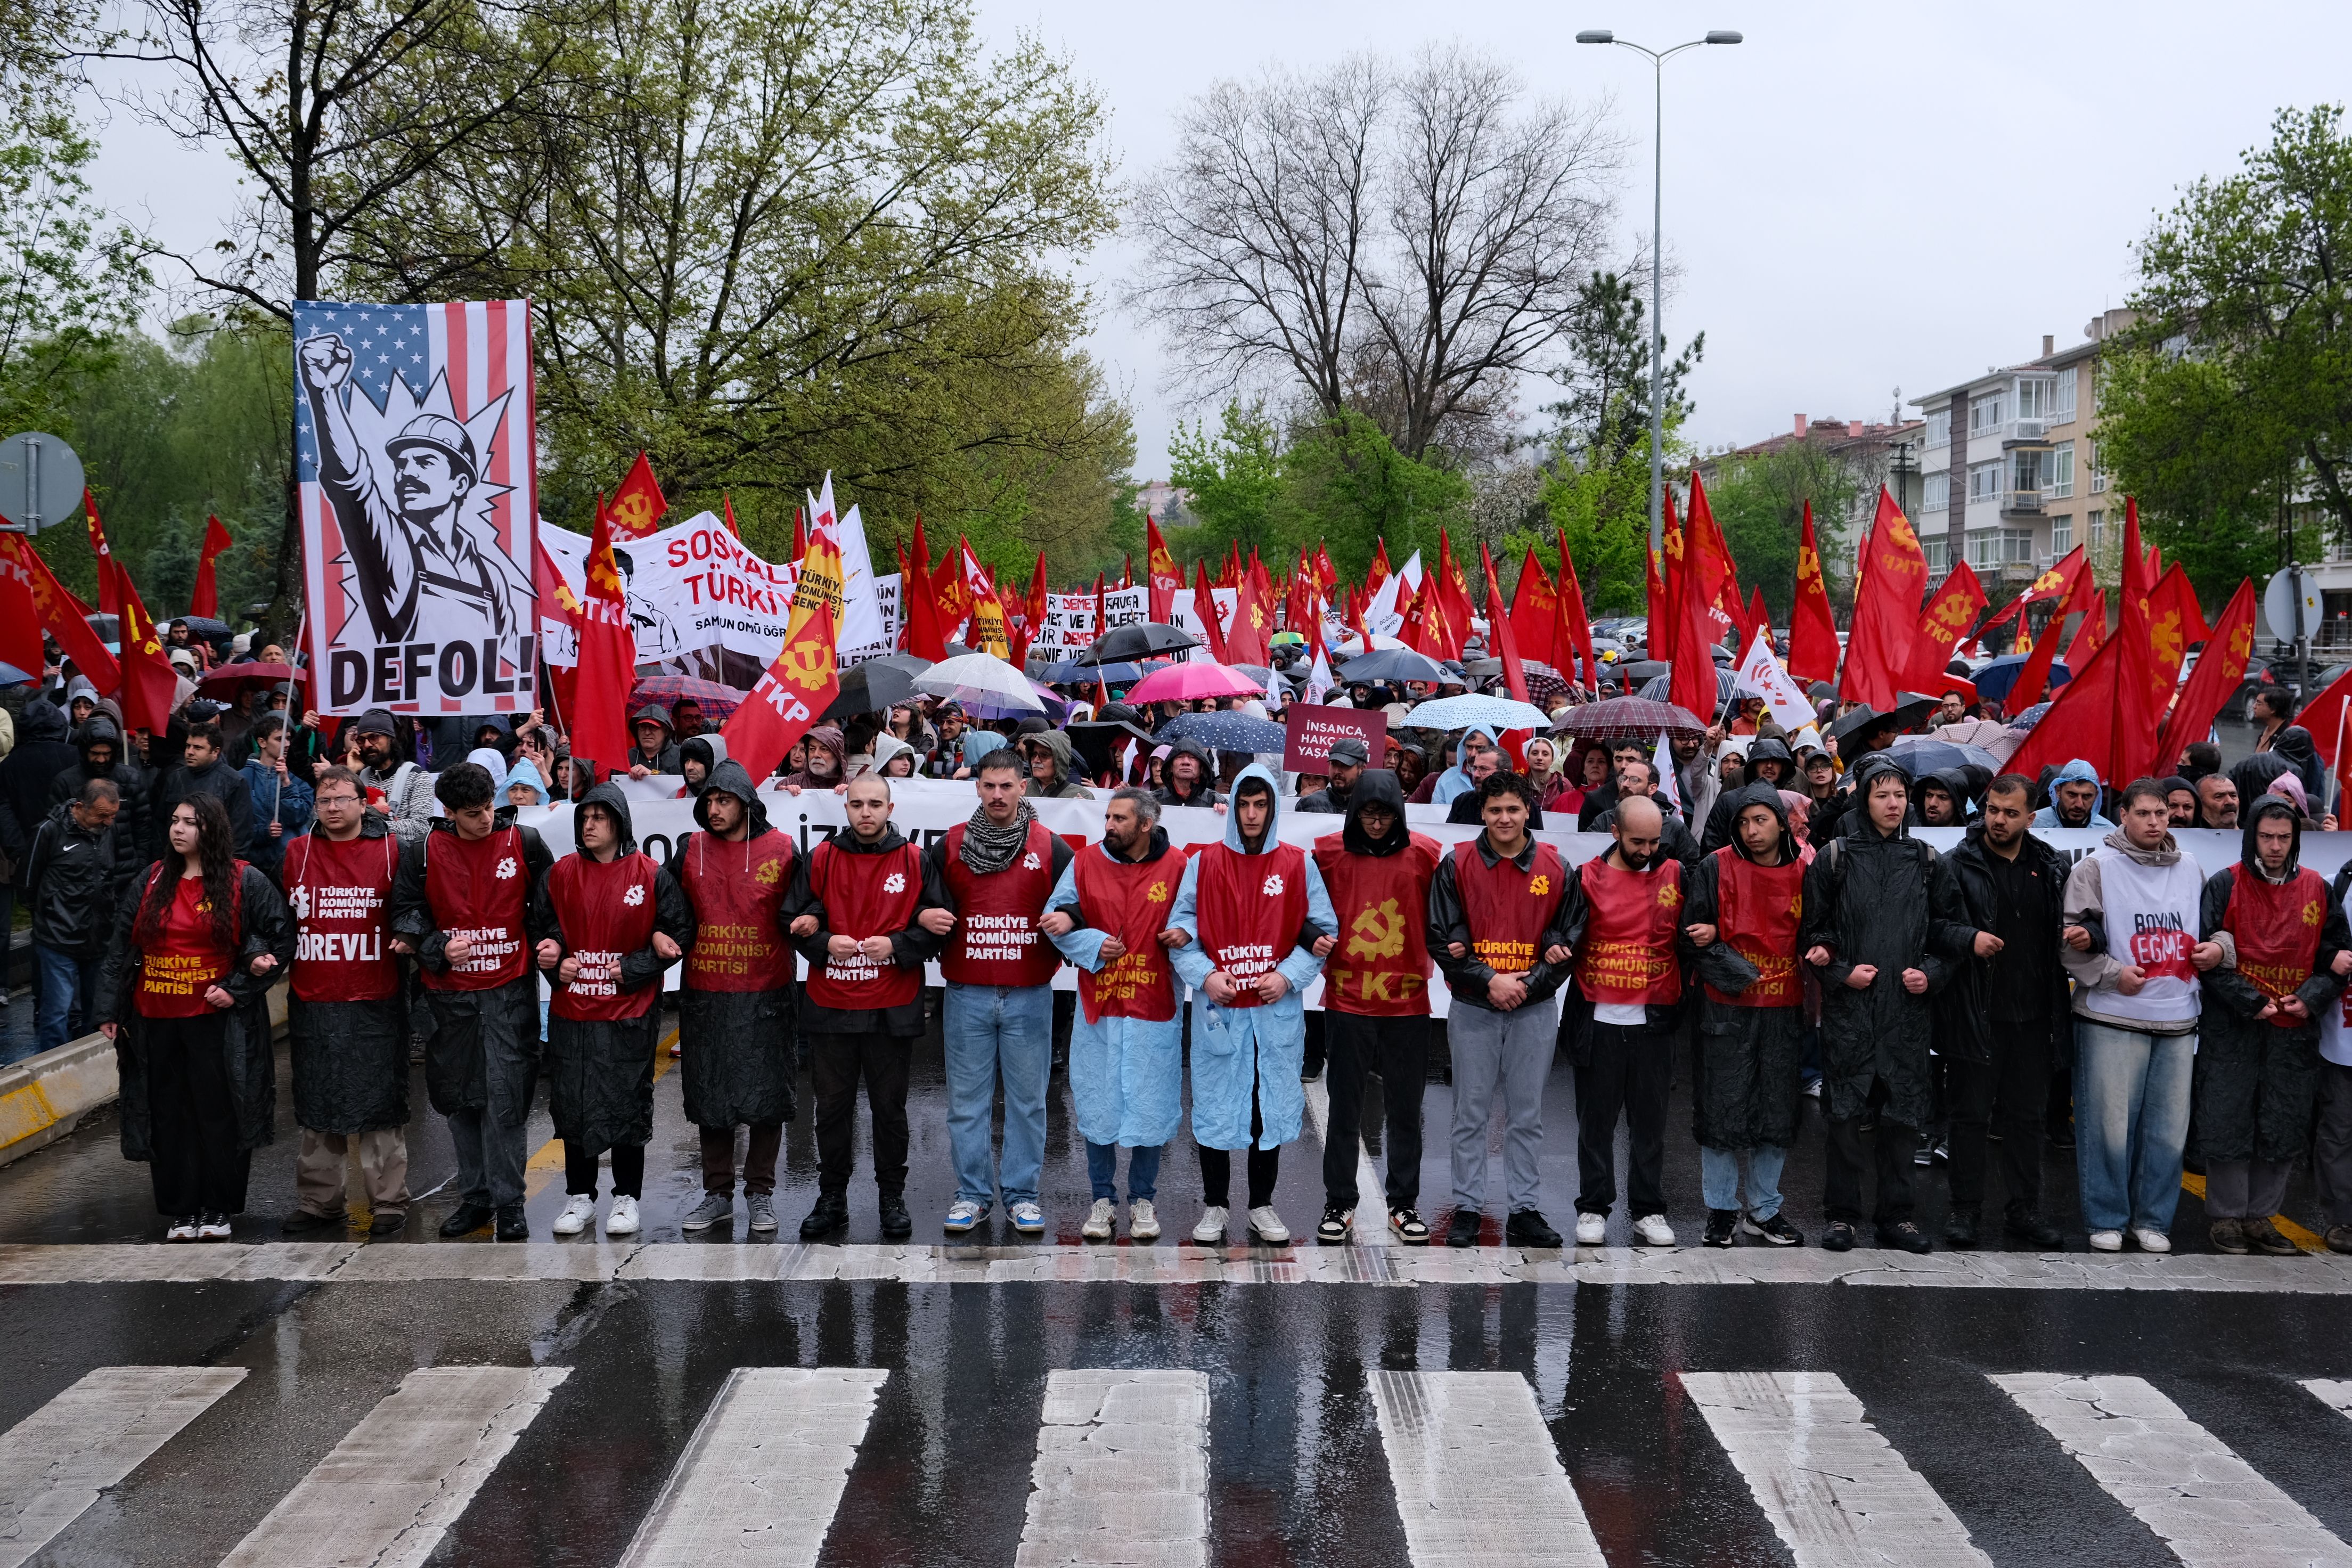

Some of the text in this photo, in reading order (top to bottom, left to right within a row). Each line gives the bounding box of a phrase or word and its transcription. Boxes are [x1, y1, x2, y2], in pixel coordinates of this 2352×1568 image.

[606, 519, 640, 542] TK
[667, 529, 802, 585] SOSYALİ
[0, 558, 31, 588] TK
[683, 562, 795, 616] TÜRKİY
[796, 582, 843, 607] KOMÜNİST
[792, 595, 840, 620] GENĞİ
[938, 595, 958, 615] TKP
[1105, 594, 1139, 610] KAVGA
[1070, 614, 1084, 628] VE
[1091, 612, 1146, 628] MMLEKET
[1708, 606, 1732, 624] TKP
[763, 625, 787, 638] ÖĞR
[1063, 631, 1095, 646] DEME
[1428, 623, 1442, 647] TK
[1924, 618, 1954, 644] TKP
[331, 636, 534, 708] DEFOL!
[753, 671, 810, 722] TKP
[1306, 720, 1366, 739] İNSANCA,
[1301, 733, 1369, 750] HAKÇ İR
[1298, 746, 1329, 759] YAŞA
[320, 886, 375, 897] TÜRKİYE
[320, 896, 383, 908] KOMÜNİST
[318, 907, 366, 918] PARTİSİ
[966, 914, 1028, 928] TÜRKİYE
[698, 922, 758, 939] TÜRKİYE
[2134, 911, 2183, 935] BOYUN
[966, 930, 1038, 944] KOMÜNİST
[468, 940, 520, 956] MÜNİST
[695, 941, 771, 957] KOMÜNİST
[966, 946, 1022, 960] PARTİSİ
[1218, 943, 1272, 961] TÜRKİYE
[1472, 939, 1534, 956] TÜRKİYE
[1589, 940, 1659, 957] TÜRKİYE
[2137, 934, 2185, 963] EĞME
[144, 954, 201, 968] TÜRKİYE
[451, 956, 501, 972] ARTİSİ
[574, 949, 623, 964] TÜRKİYE
[1104, 952, 1147, 969] KİYE
[1476, 956, 1538, 970] OMÜNİ
[1740, 949, 1793, 969] RKİYE
[577, 966, 614, 979] OMÜN
[692, 958, 748, 974] PARTİSİ
[826, 967, 879, 981] PARTİSİ
[1222, 958, 1279, 976] KOMÜNİ
[1587, 957, 1670, 975] KOMÜNİST
[2237, 961, 2305, 981] ÜRKİYE
[143, 980, 193, 995] PARTİSİ
[568, 981, 617, 995] PARTİSİ
[1332, 969, 1423, 1001] TKP
[1586, 973, 1647, 989] PARTİSİ
[1741, 979, 1783, 995] RTİSİ
